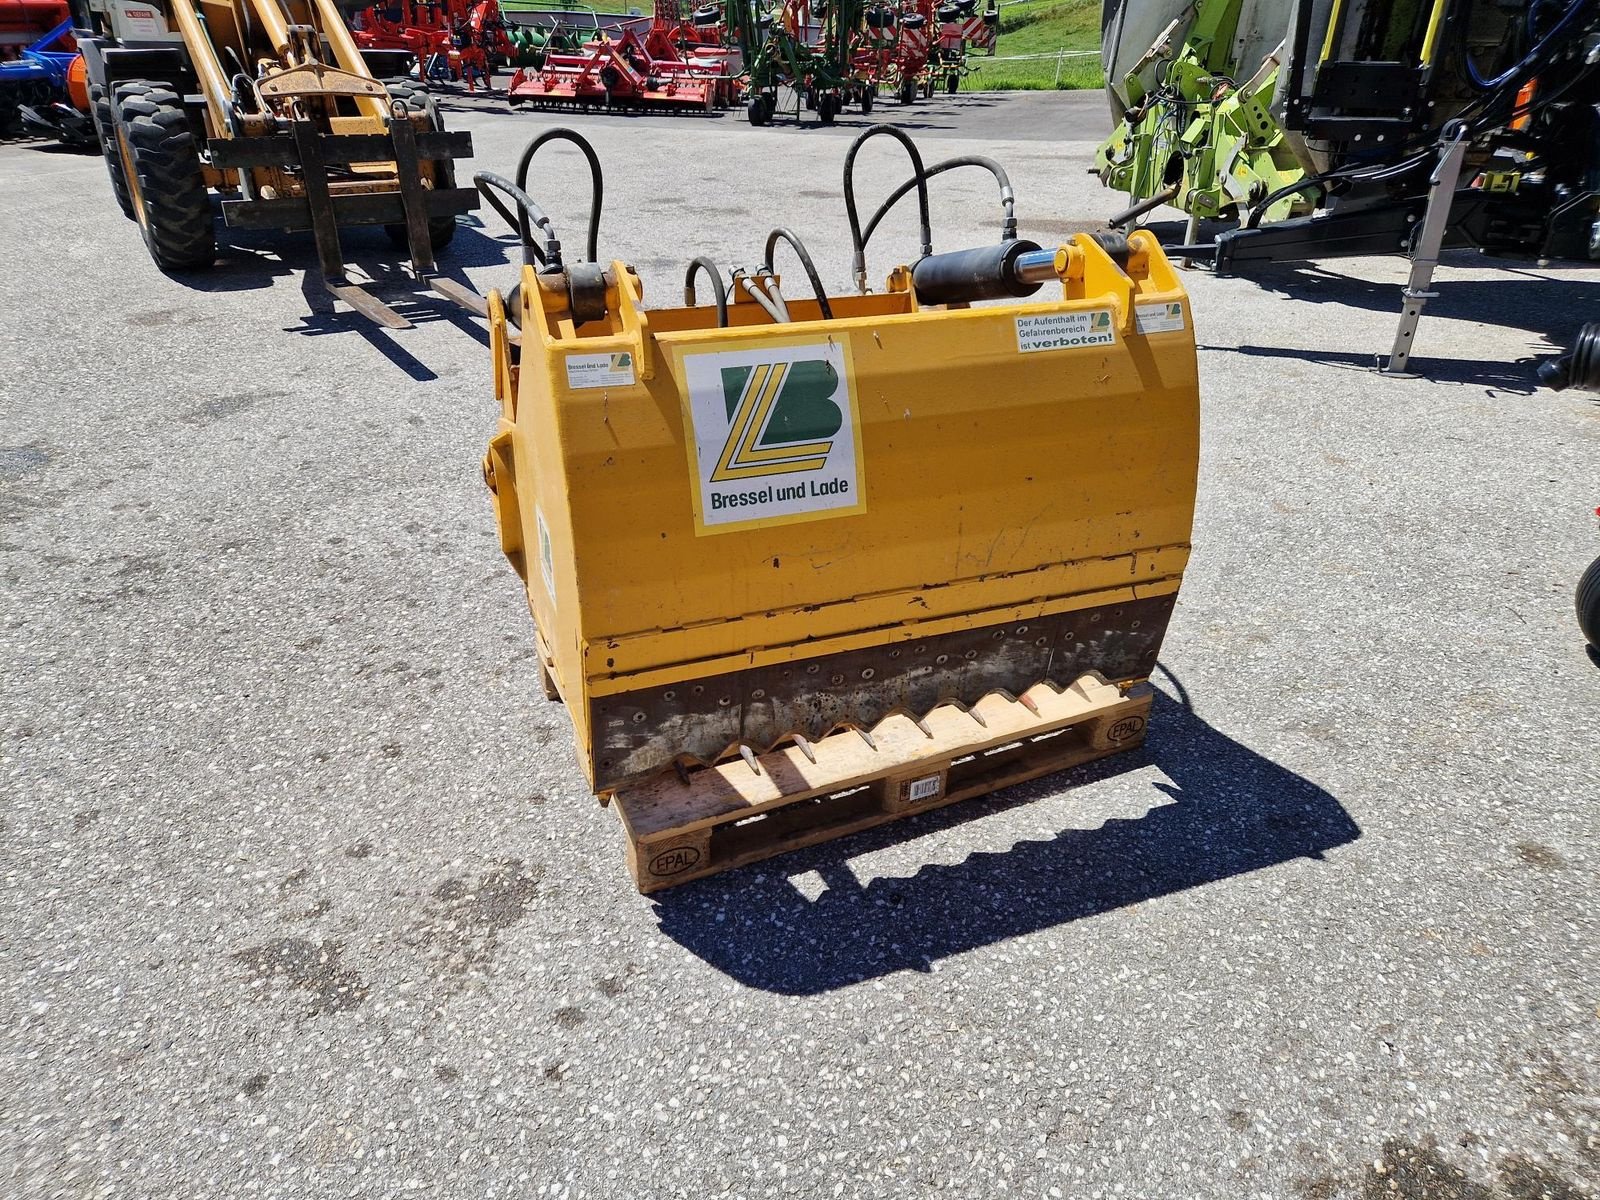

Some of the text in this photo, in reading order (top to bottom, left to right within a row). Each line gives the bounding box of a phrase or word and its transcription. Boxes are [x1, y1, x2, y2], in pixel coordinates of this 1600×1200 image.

[1017, 319, 1033, 328] Der
[1034, 315, 1075, 326] Aufenthalt
[1019, 326, 1086, 338] Gefahrenbereich
[1033, 333, 1113, 349] verboten!
[711, 478, 849, 510] Bressel und Lade
[1113, 720, 1138, 737] EPAL
[656, 851, 693, 871] EPAL
